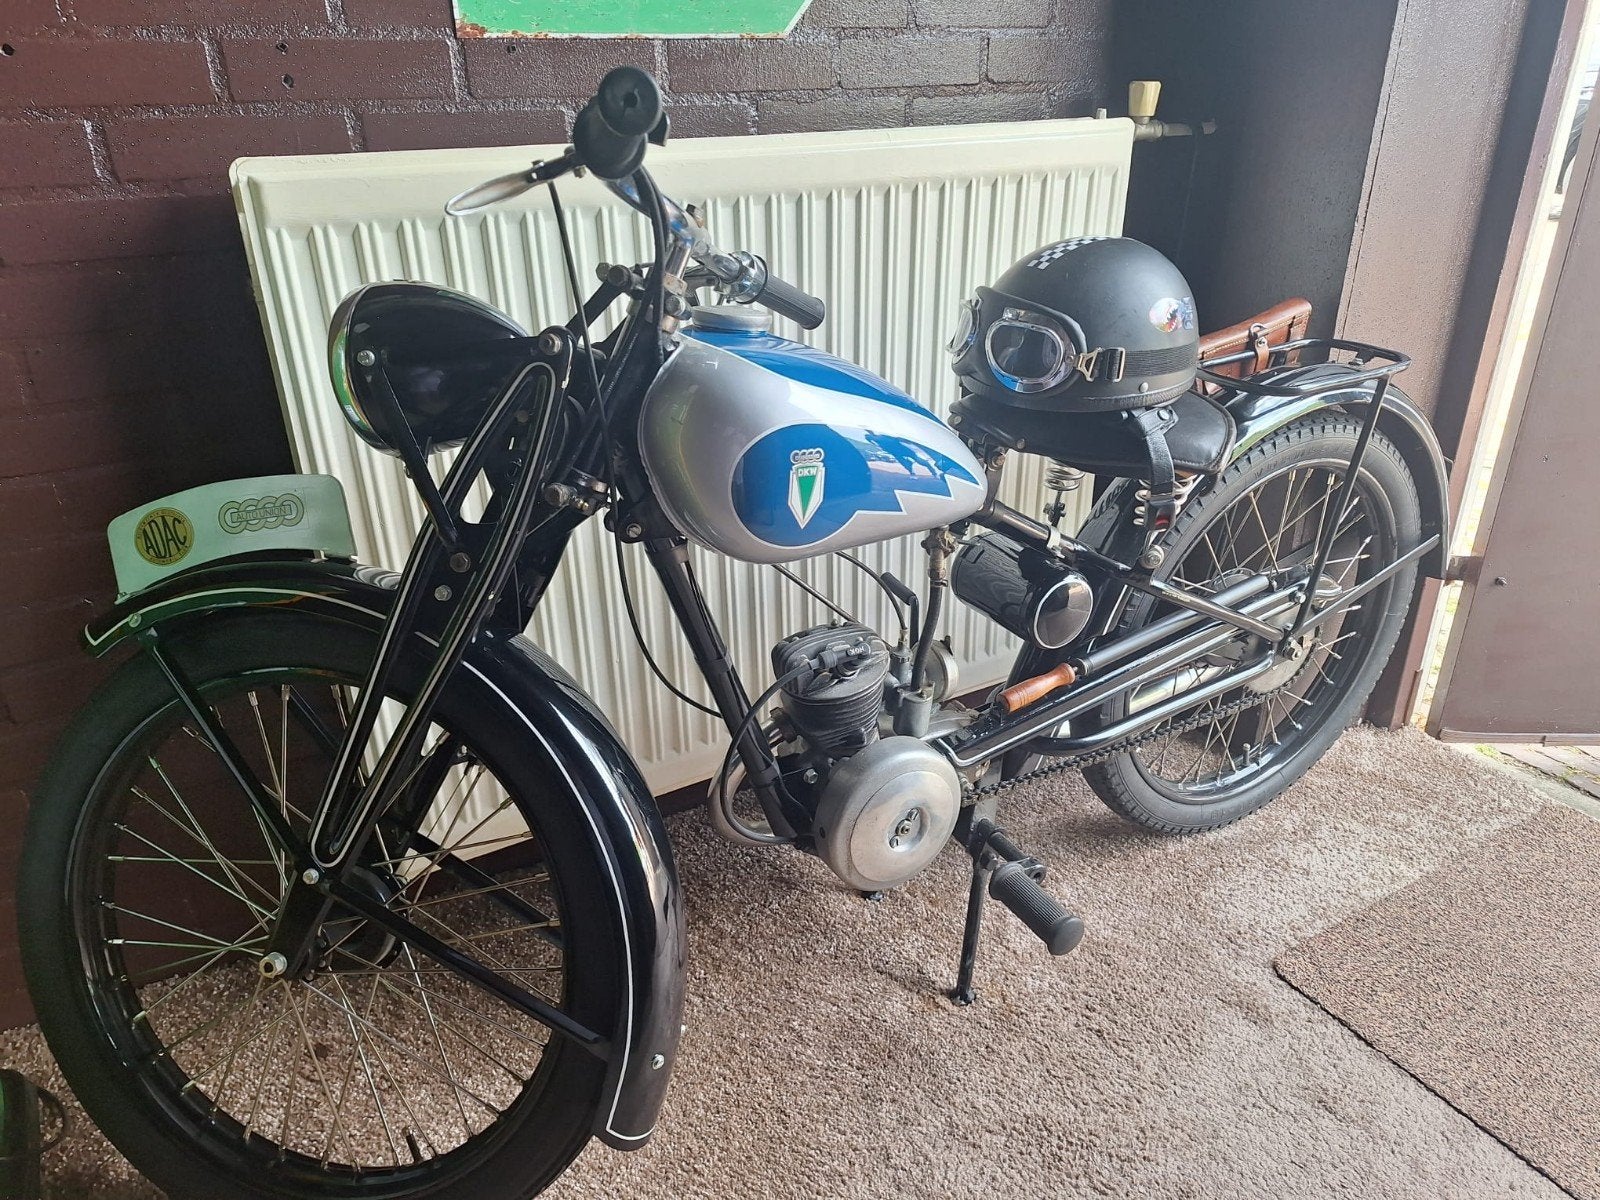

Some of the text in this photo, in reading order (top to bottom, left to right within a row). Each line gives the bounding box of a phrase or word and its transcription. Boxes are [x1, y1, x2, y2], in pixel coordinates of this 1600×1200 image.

[798, 467, 817, 477] DKW
[237, 506, 287, 520] AUTO UNION
[143, 515, 187, 558] ADAC
